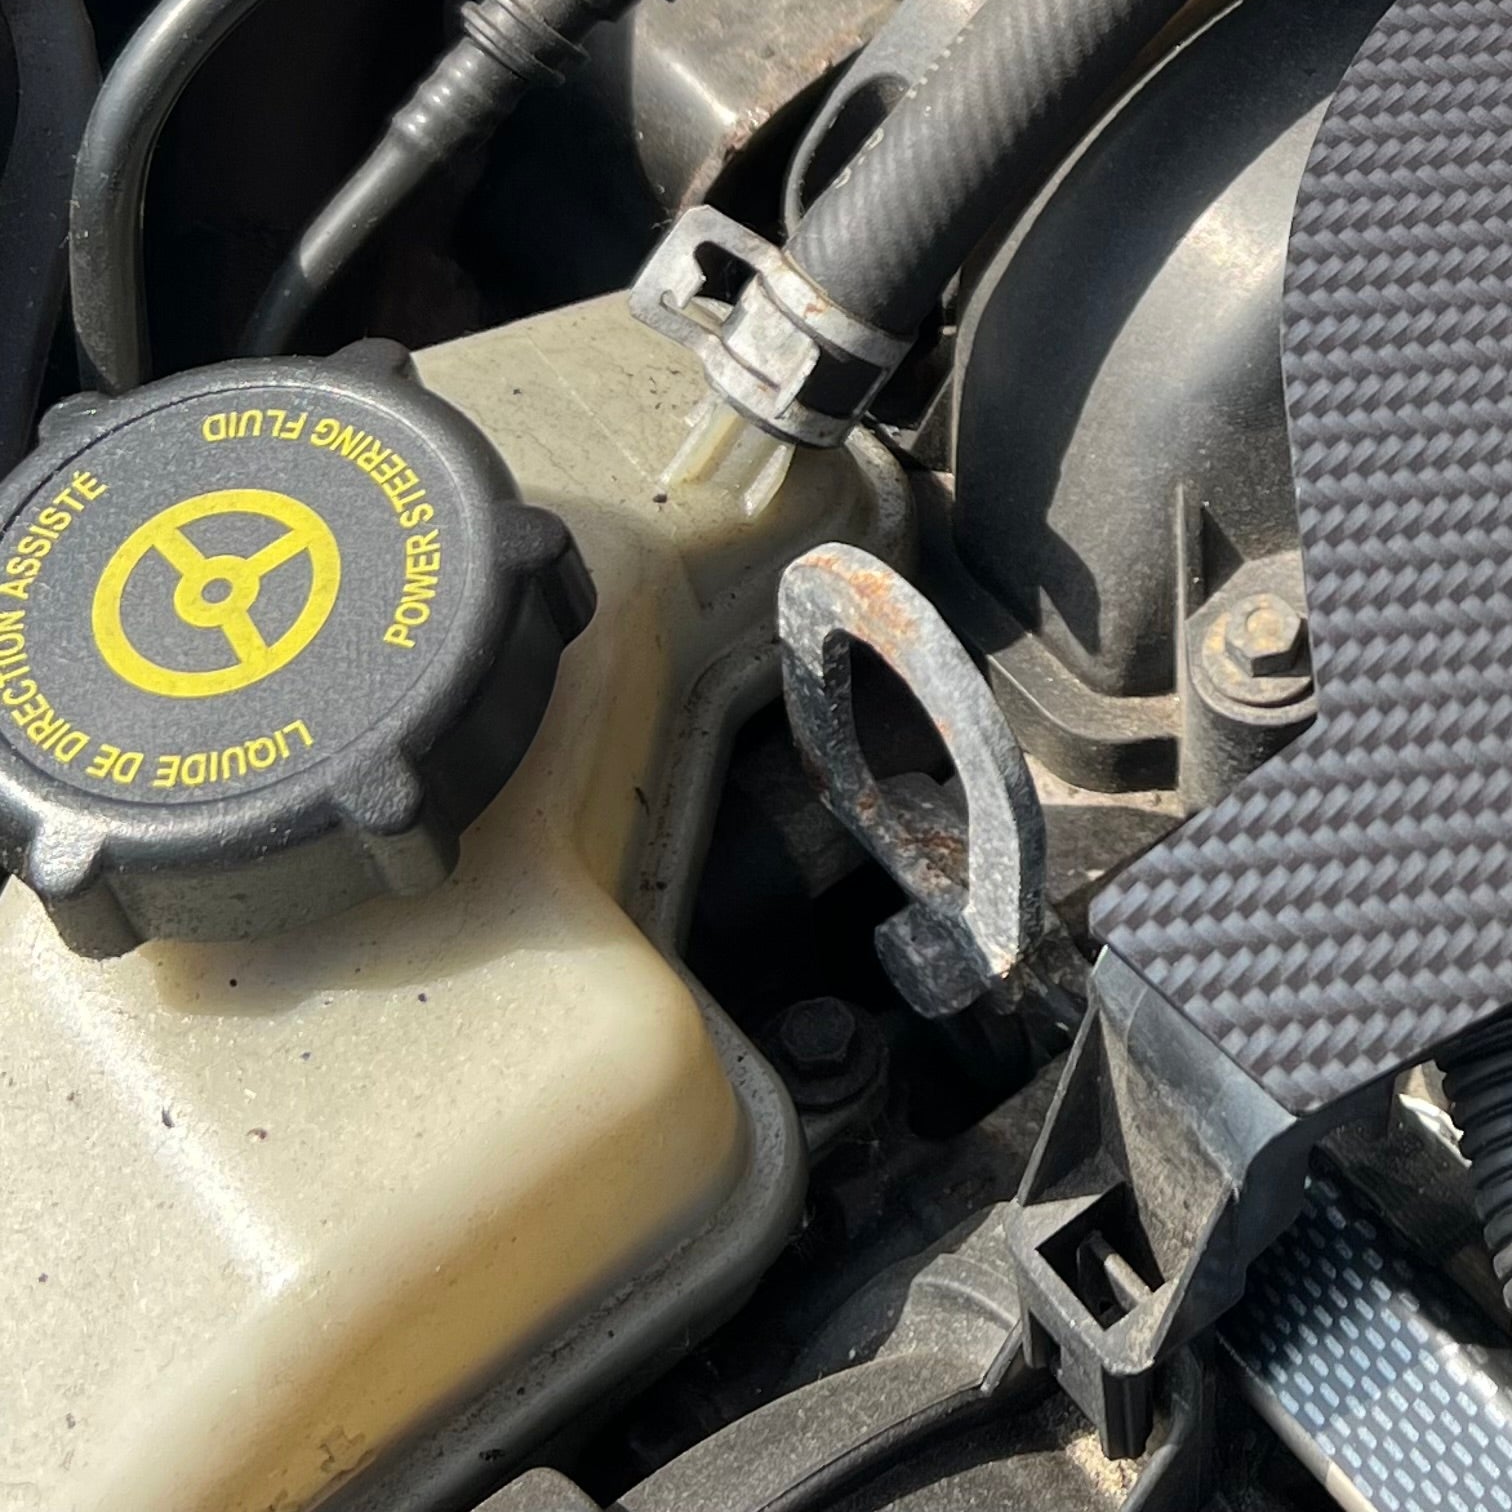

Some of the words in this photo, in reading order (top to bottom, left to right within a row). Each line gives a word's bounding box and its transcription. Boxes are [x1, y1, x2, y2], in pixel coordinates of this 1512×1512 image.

[202, 409, 307, 443] FLUID
[310, 419, 434, 529] STEERING
[383, 527, 441, 649] POWER
[0, 609, 91, 764] DIRECTION
[87, 745, 145, 785] DE
[154, 720, 314, 788] LIQUIDE
